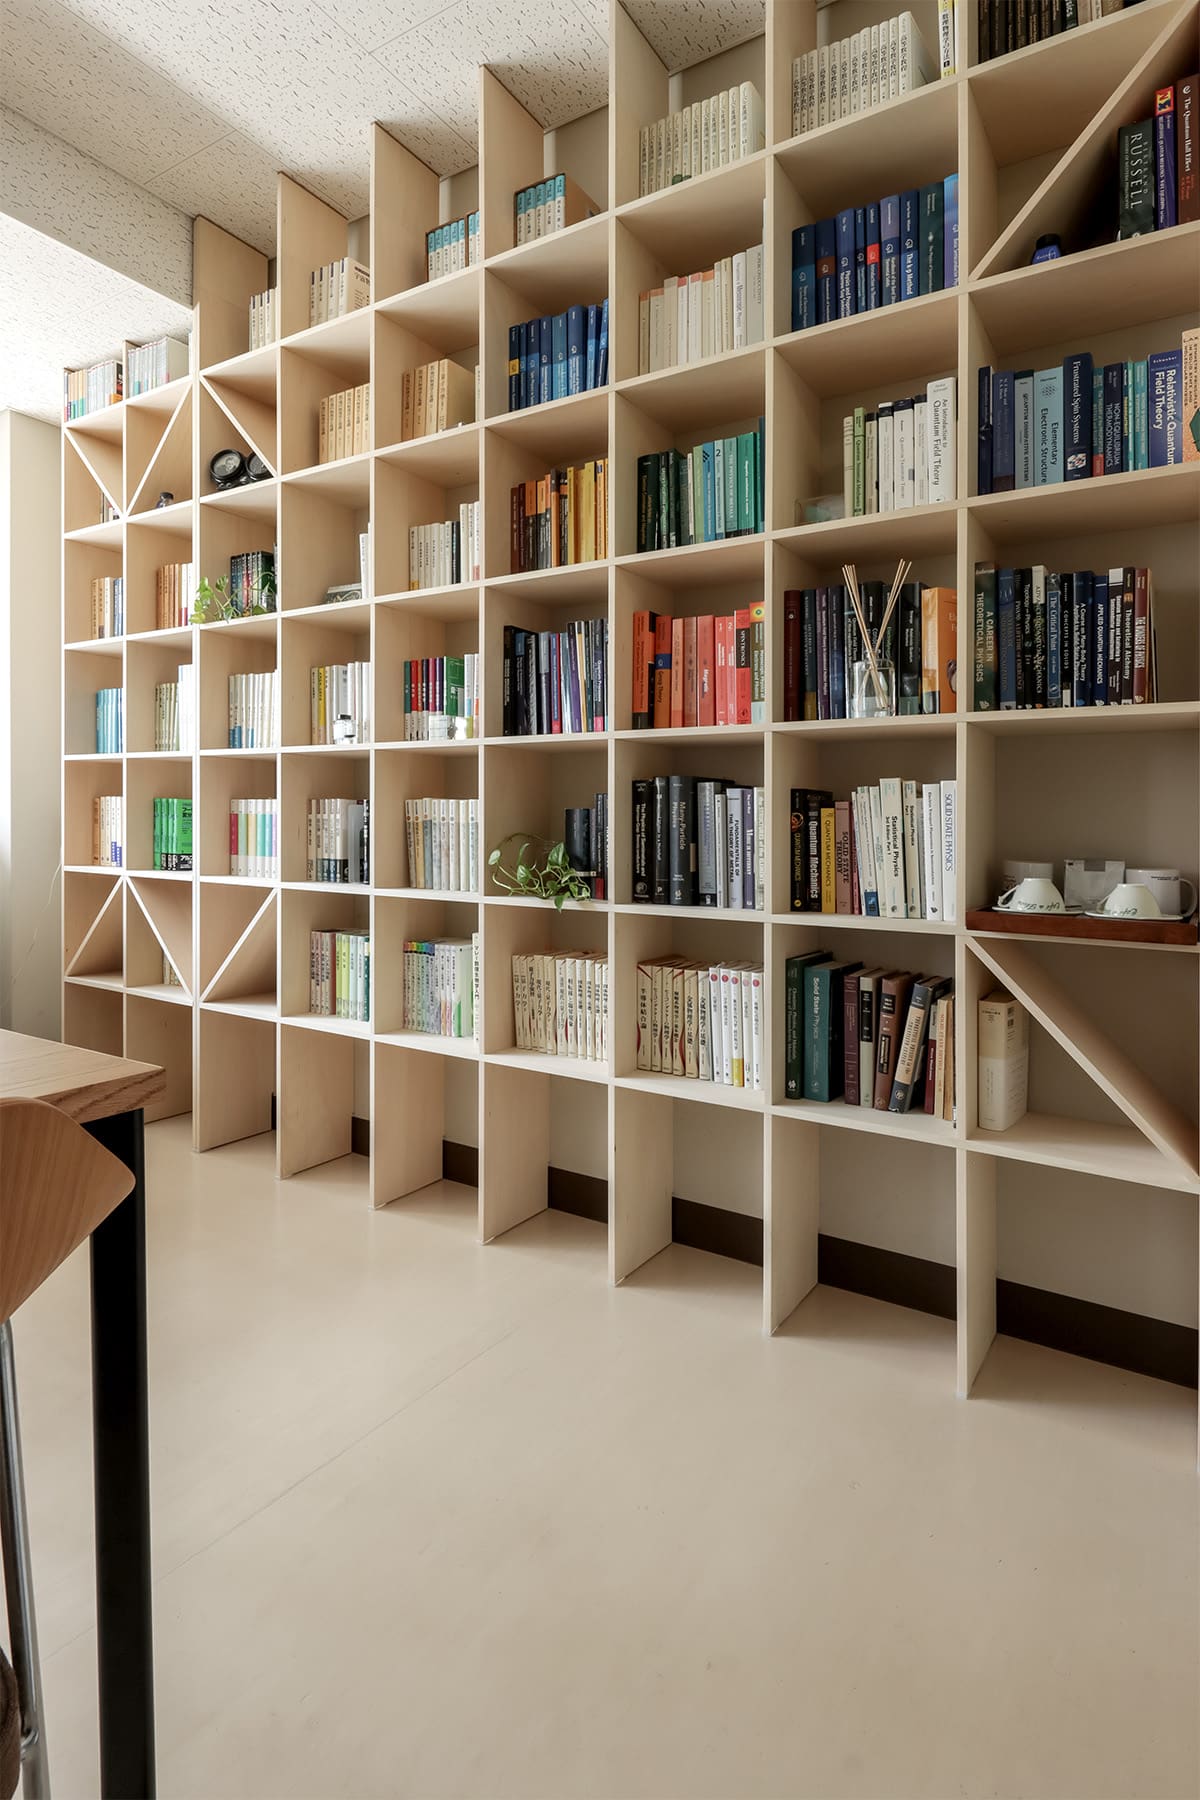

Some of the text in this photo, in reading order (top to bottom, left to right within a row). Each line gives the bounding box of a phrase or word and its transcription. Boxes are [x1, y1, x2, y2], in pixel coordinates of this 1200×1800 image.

[1184, 98, 1192, 108] The
[1184, 109, 1192, 138] Quantum
[1130, 133, 1142, 208] RUSSELL
[1184, 140, 1192, 154] Hall
[1184, 154, 1192, 172] Effect
[906, 274, 914, 294] Method
[1072, 361, 1081, 444] Frustrated Spin Systems
[1154, 372, 1165, 429] Field Theory
[1166, 370, 1176, 465] Relativistic Quantum
[932, 400, 942, 486] Quantum Field Theory
[1050, 422, 1060, 465] Elementary
[976, 592, 984, 682] THEORETICAL PHYSICS
[1124, 609, 1132, 680] Theoretical Alchemy
[808, 821, 818, 898] Quantum Mechanics
[892, 816, 900, 876] Statistical Physics
[944, 794, 952, 871] SOLID STATE PHYSICS
